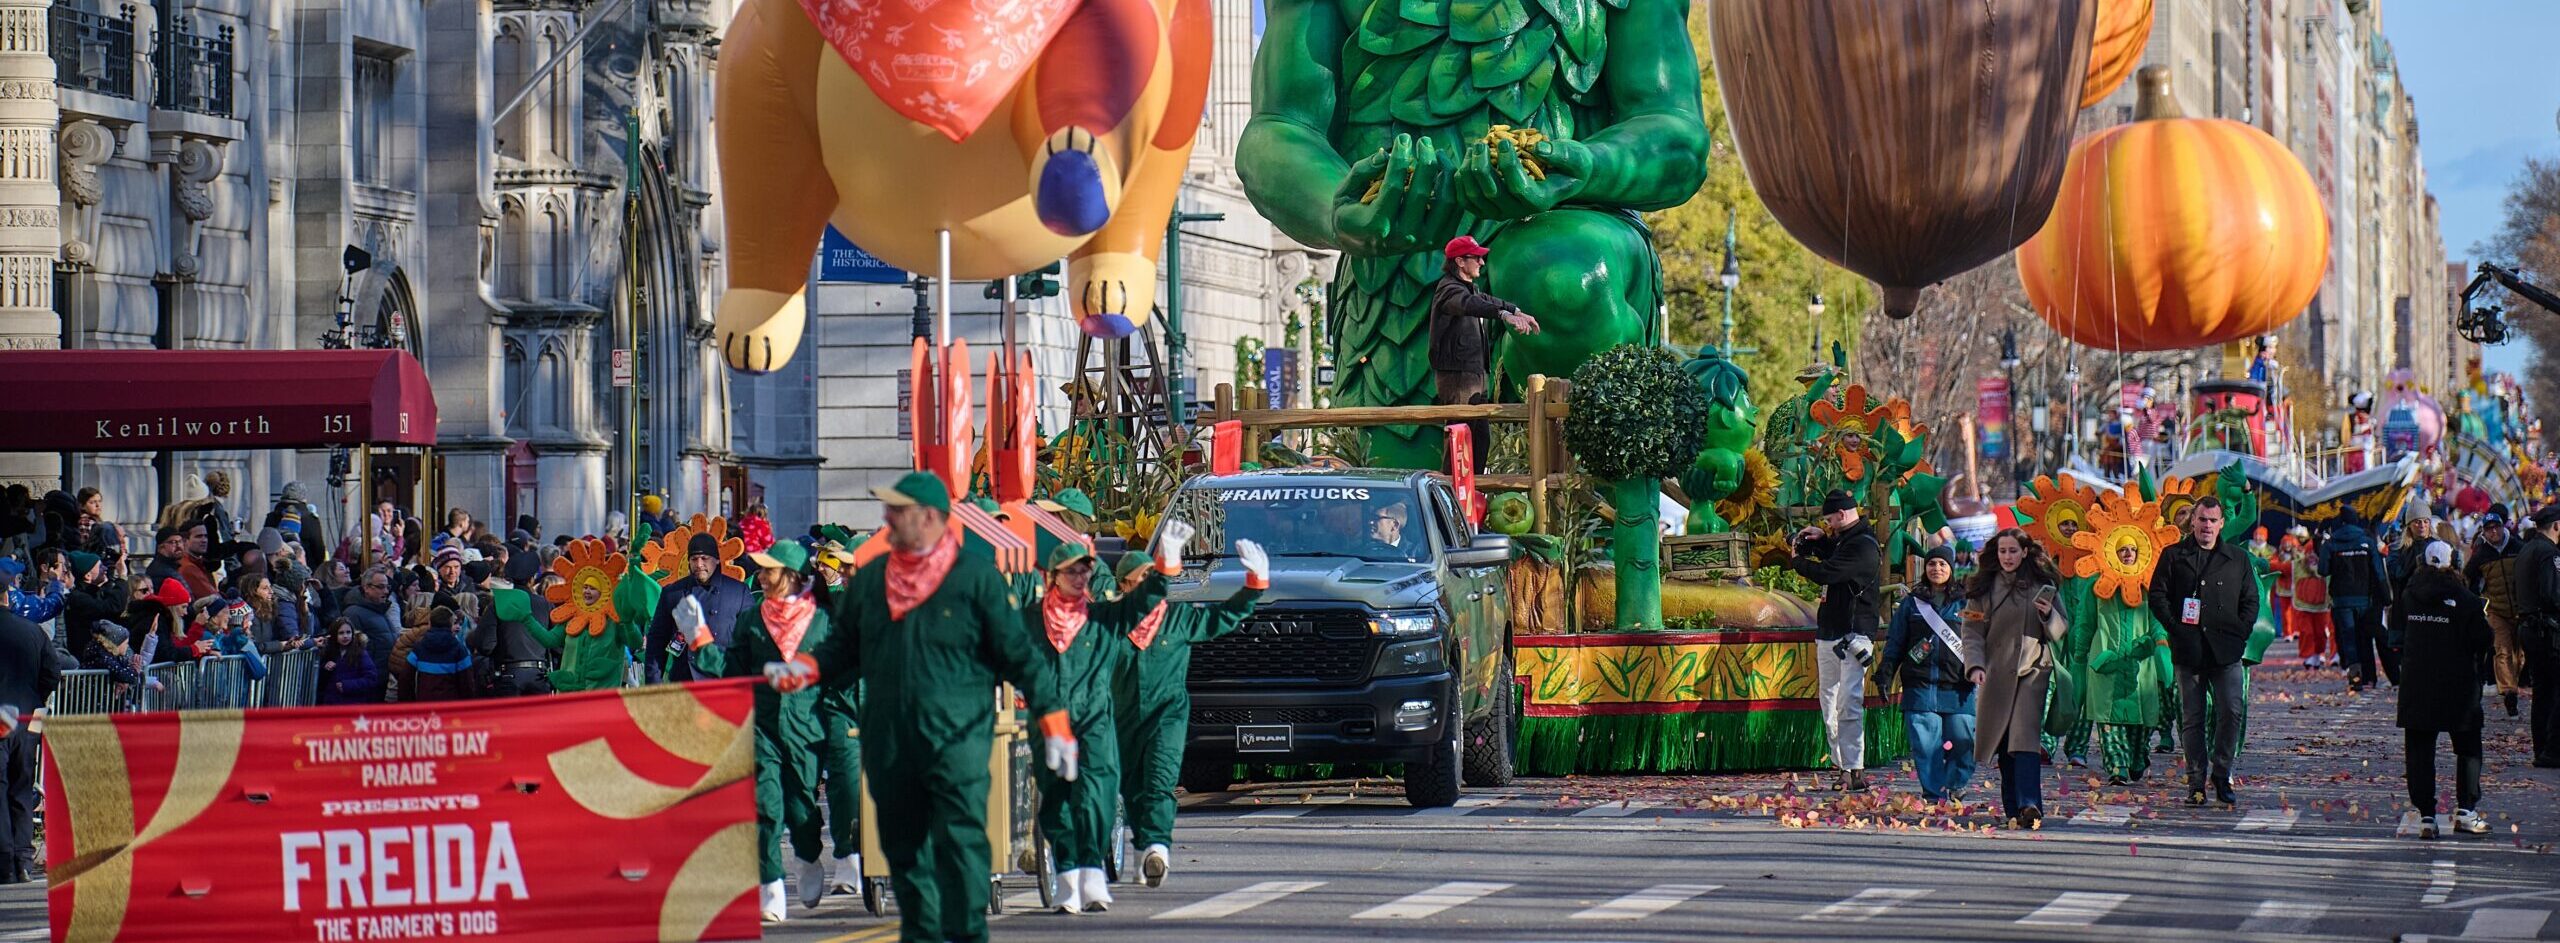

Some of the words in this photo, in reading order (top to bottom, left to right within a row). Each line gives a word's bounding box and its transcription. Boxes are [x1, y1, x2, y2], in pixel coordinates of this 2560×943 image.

[832, 249, 855, 258] THE
[832, 258, 897, 268] HISTORIC
[95, 415, 271, 438] Kenilworth
[322, 414, 352, 433] 151
[399, 412, 409, 434] 151
[1218, 488, 1370, 501] #RAMTRUCKS
[372, 712, 442, 735] macy's
[306, 735, 447, 763] THANKSGIVING
[452, 732, 489, 755] DAY
[361, 762, 437, 787] PARADE
[322, 795, 480, 816] PRESENTS
[280, 821, 529, 911] FREIDA
[313, 918, 352, 943] THE
[356, 913, 454, 939] FARMER'S
[459, 910, 497, 934] DOG
